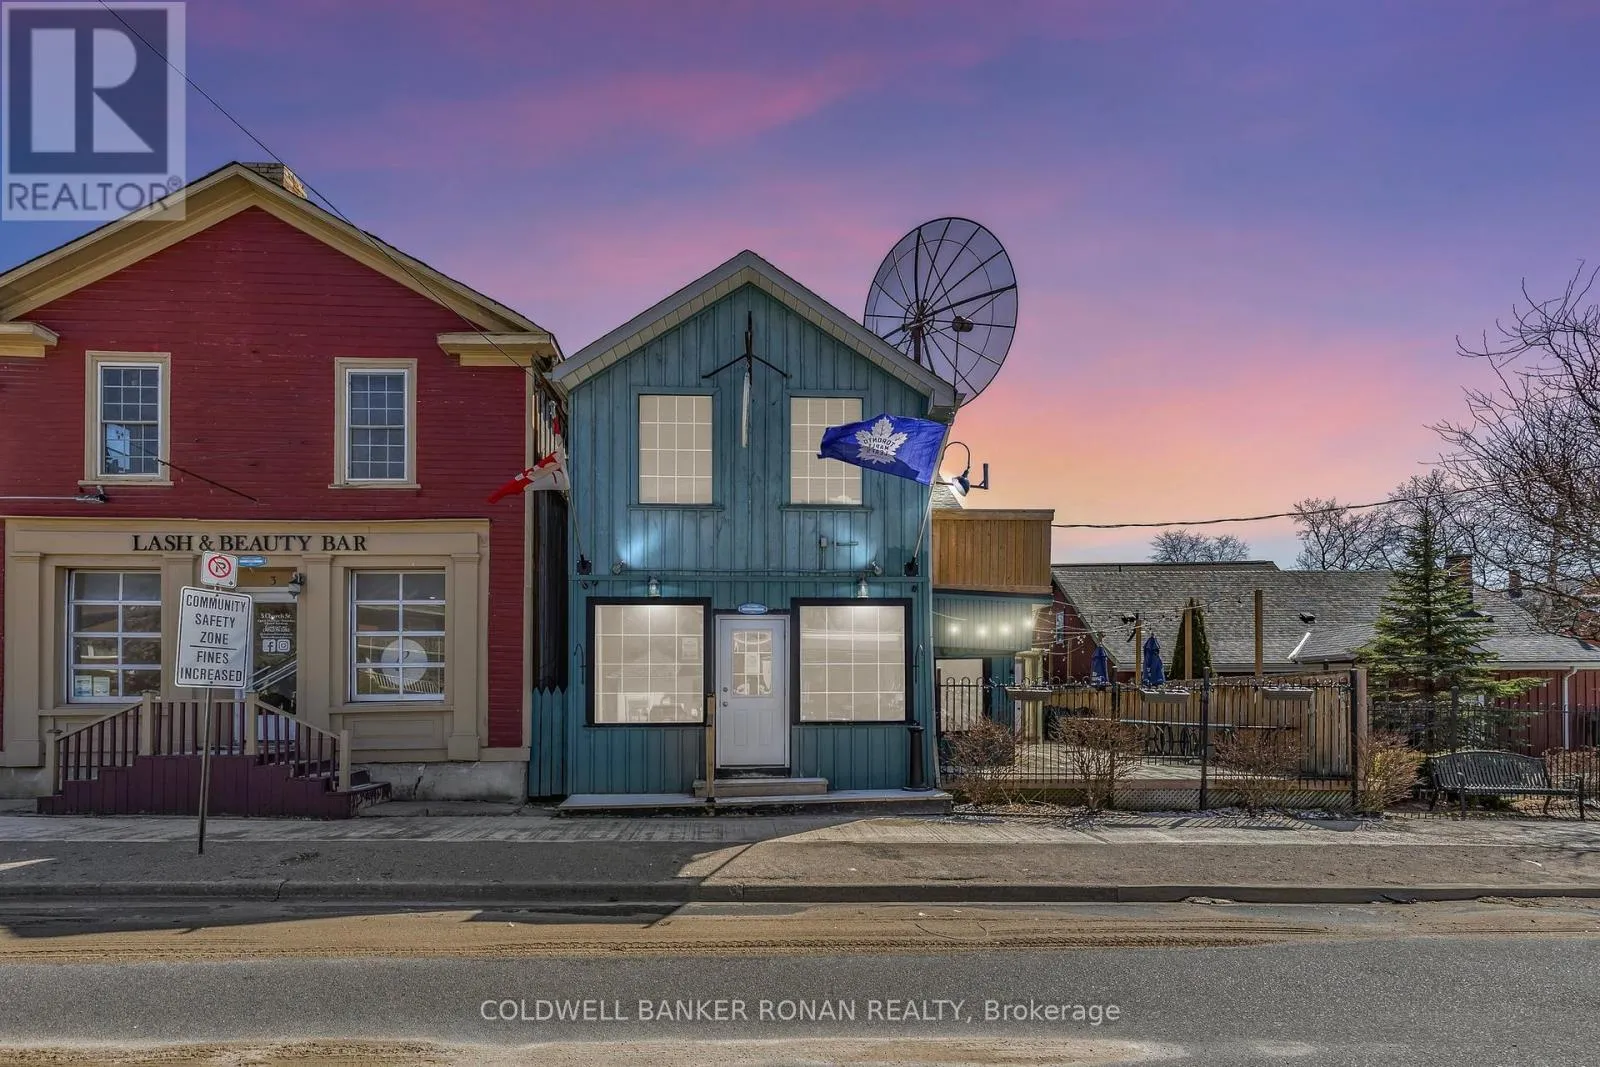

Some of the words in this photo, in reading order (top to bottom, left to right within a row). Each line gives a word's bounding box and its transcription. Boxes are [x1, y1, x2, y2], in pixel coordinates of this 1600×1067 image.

[132, 535, 193, 551] LASH
[199, 535, 214, 551] &
[220, 535, 311, 551] BEAUTY
[322, 535, 367, 551] BAR
[270, 575, 277, 585] 3
[186, 594, 246, 613] COMMUNITY
[195, 613, 236, 628] SAFETY
[200, 631, 229, 645] ZONE
[196, 651, 229, 665] FINES
[180, 667, 242, 682] INCREASED
